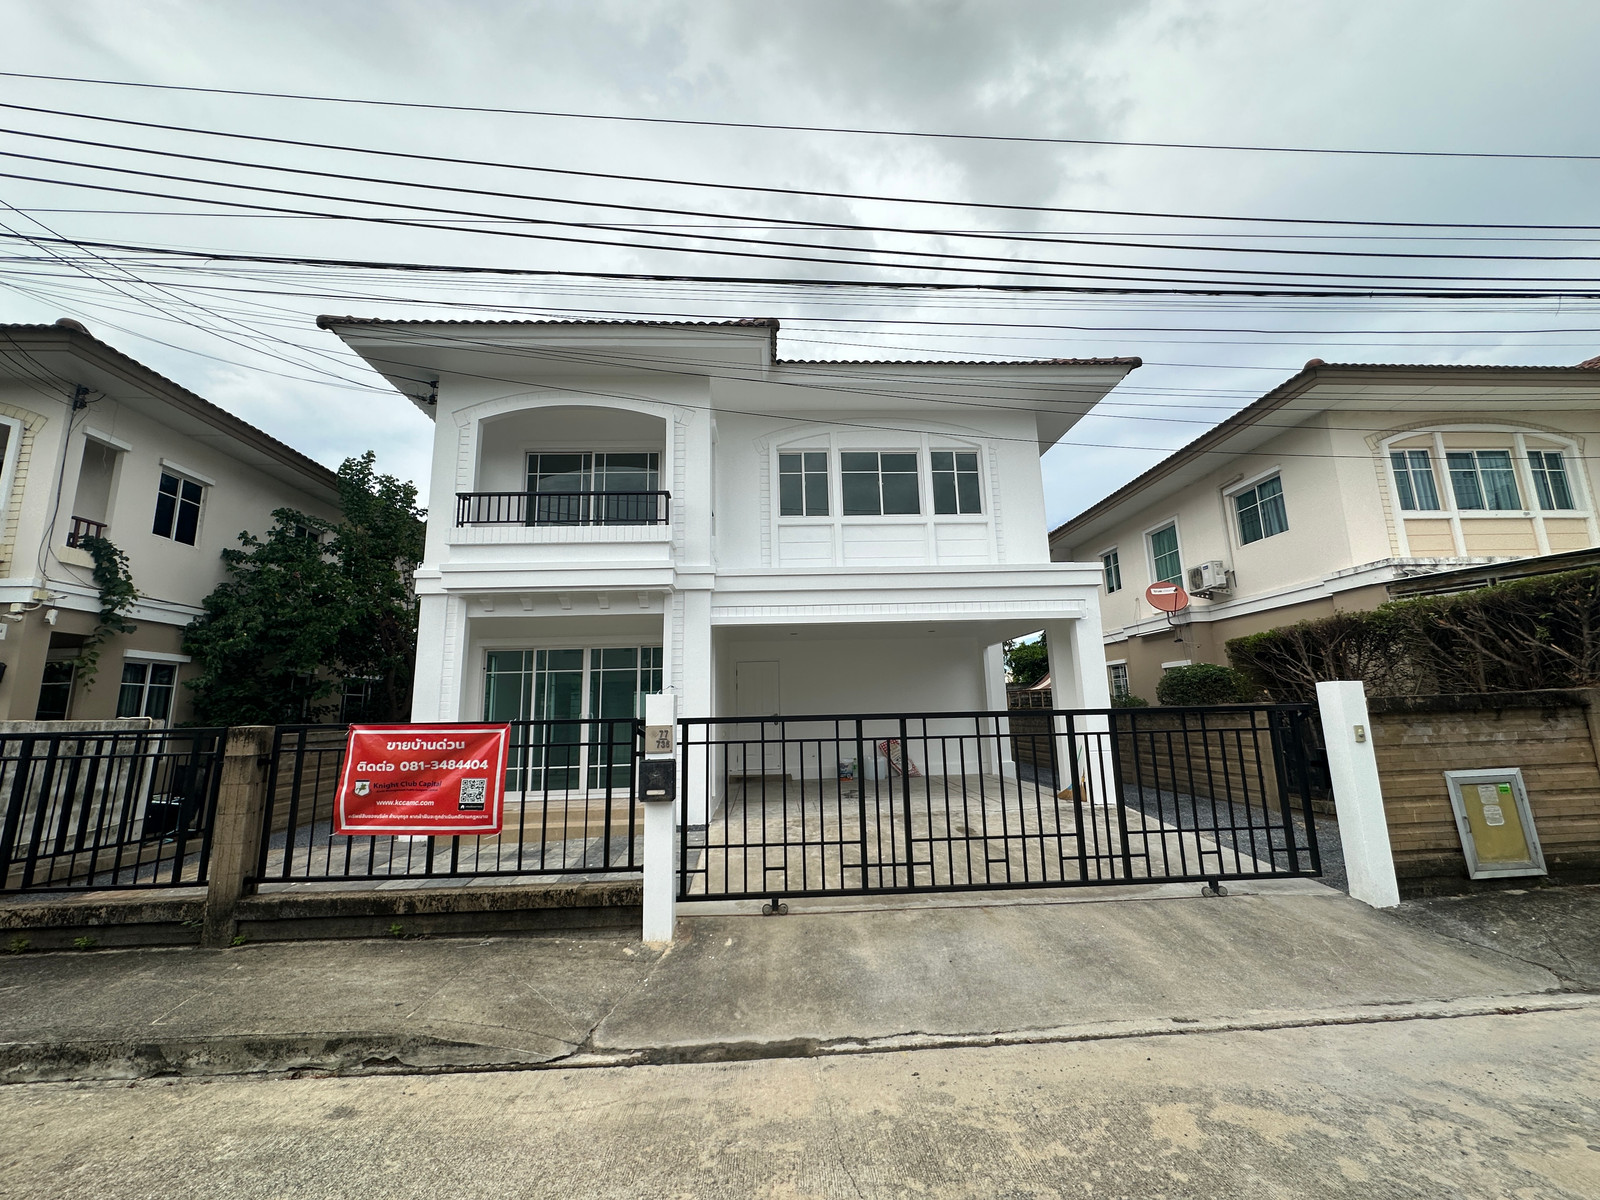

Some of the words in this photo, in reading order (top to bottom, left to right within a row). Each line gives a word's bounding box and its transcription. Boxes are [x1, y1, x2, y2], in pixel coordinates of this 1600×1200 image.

[658, 730, 669, 738] 77
[386, 738, 465, 750] ขายบ้านด่วน
[356, 760, 395, 772] ติดต่อ
[400, 760, 488, 771] 081-3484404
[419, 780, 442, 788] Capital
